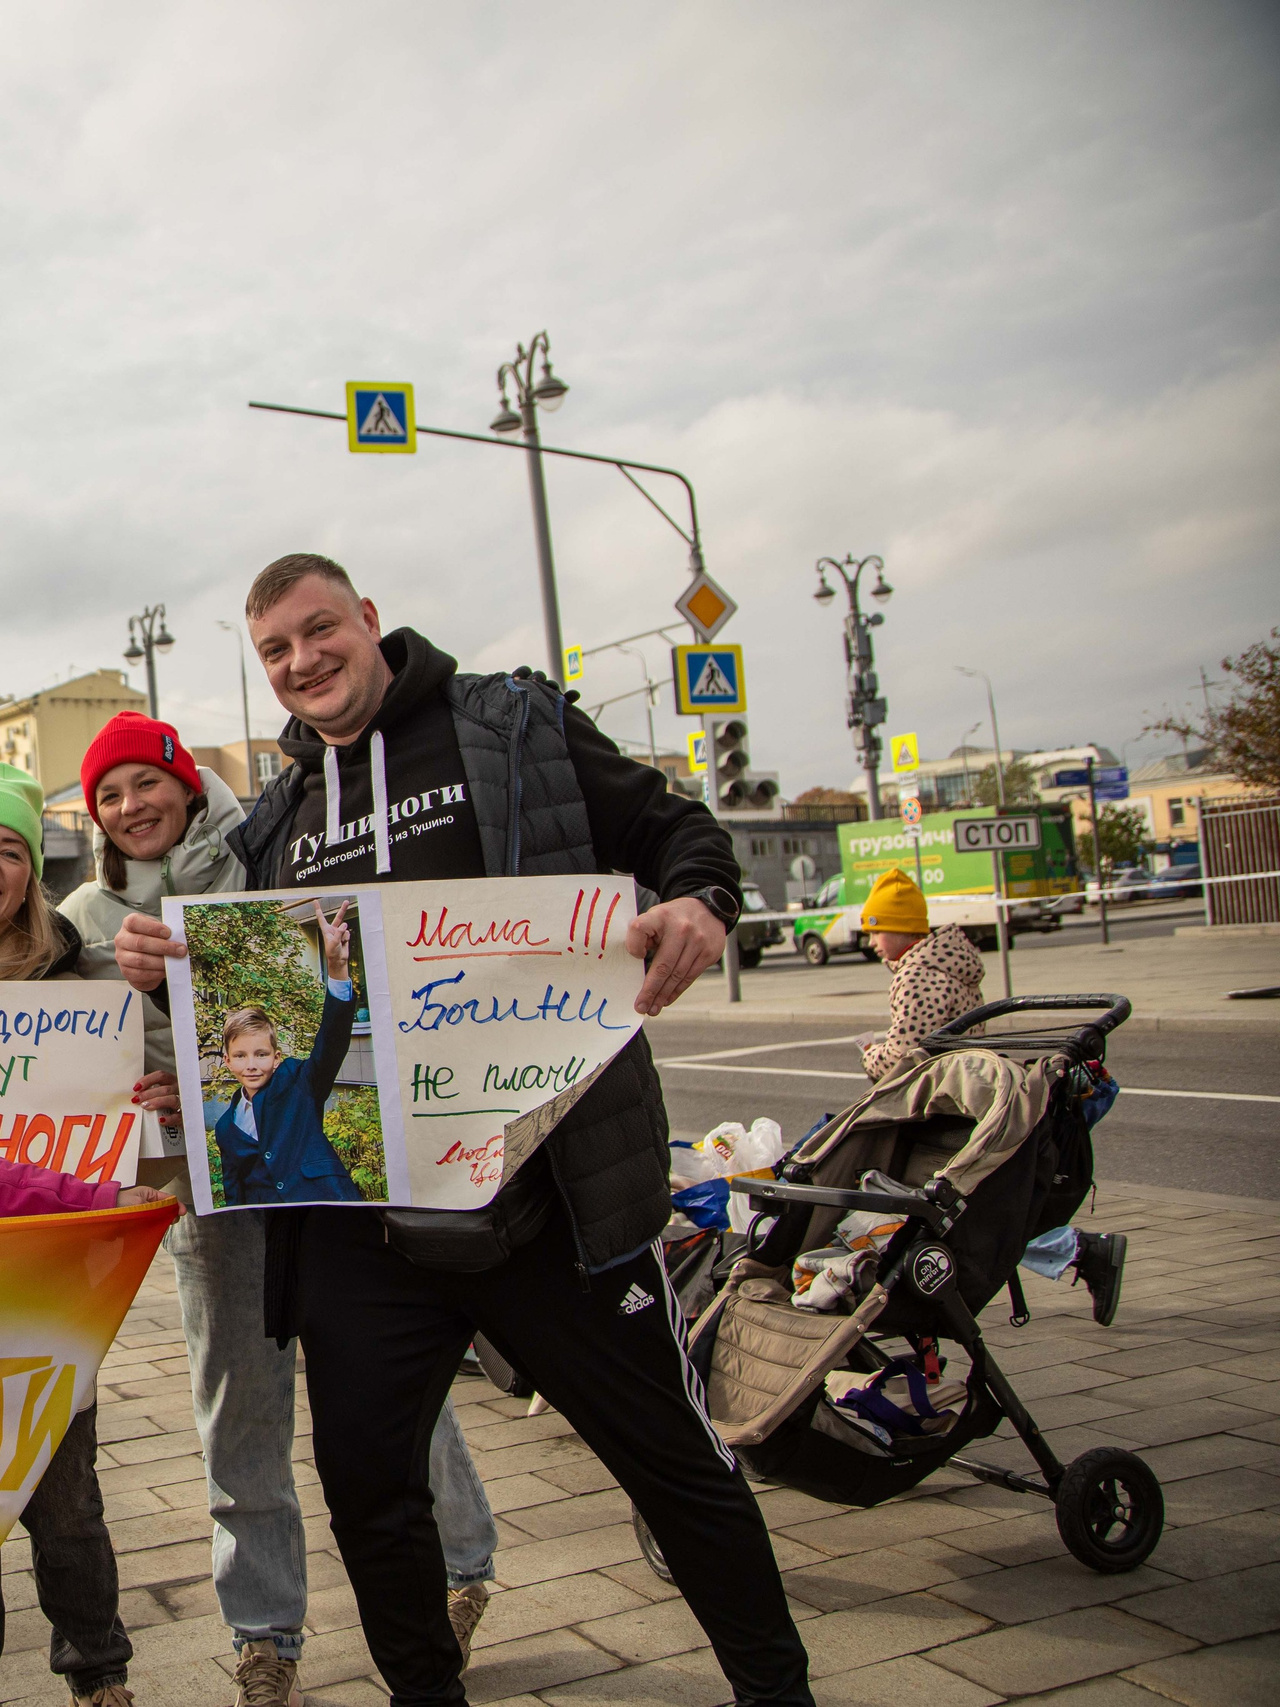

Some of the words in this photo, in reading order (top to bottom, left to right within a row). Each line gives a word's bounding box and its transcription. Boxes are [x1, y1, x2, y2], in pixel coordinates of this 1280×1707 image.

[323, 845, 366, 868] беговой
[395, 831, 409, 842] из
[410, 815, 454, 837] Тушино
[965, 822, 1031, 846] СТОП
[406, 907, 550, 949] Мама
[617, 1294, 655, 1316] adidas
